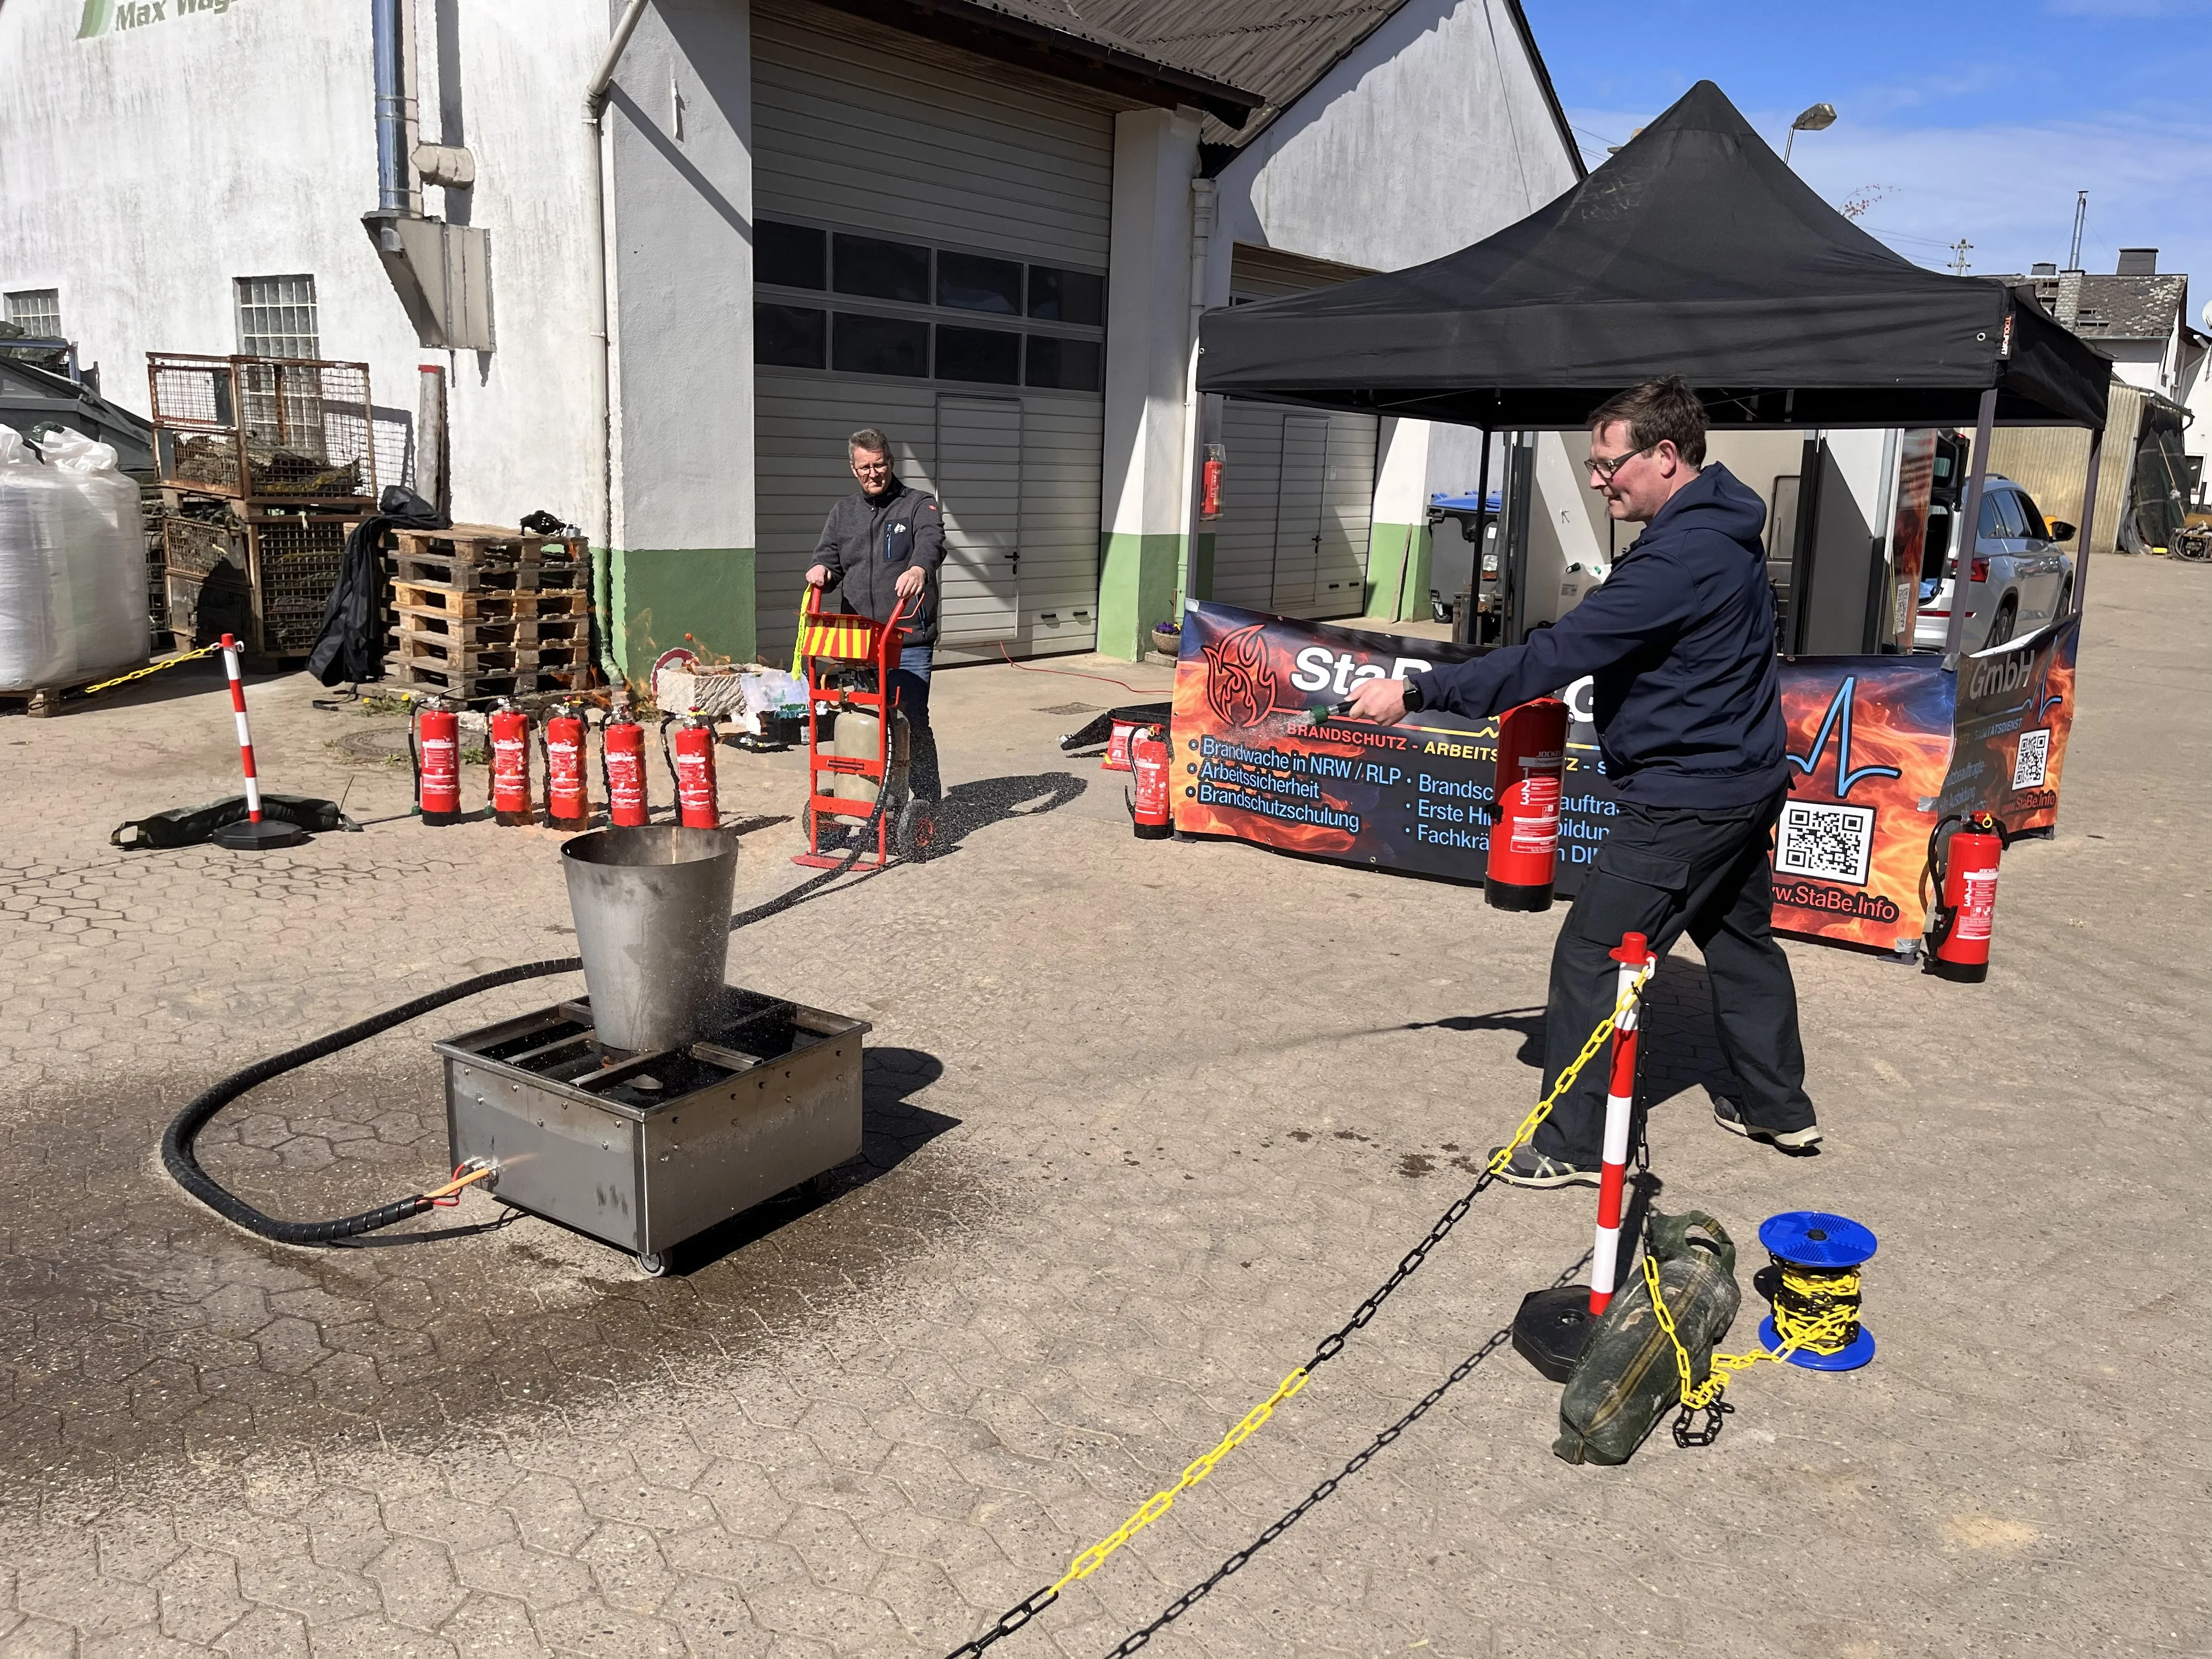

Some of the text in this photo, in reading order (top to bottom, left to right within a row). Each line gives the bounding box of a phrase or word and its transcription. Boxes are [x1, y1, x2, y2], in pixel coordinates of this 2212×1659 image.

[116, 0, 166, 30] Max
[2001, 315, 2012, 356] TOOLPORT
[1969, 649, 2035, 699] GmbH
[1287, 723, 1407, 751] BRANDSCHUTZ
[1203, 737, 1289, 770] Brandwache
[1292, 754, 1306, 771] in
[1310, 756, 1351, 778] NRW
[1365, 765, 1402, 785] RLP
[1522, 767, 1529, 780] 1
[1200, 761, 1319, 799] Arbeitssicherheit
[1521, 779, 1531, 792] 2
[1200, 784, 1359, 833] Brandschutzschulung
[1418, 799, 1464, 821] Erste
[1520, 792, 1530, 805] 3
[1417, 823, 1489, 851] Fachkrä
[1571, 845, 1598, 864] DI
[1964, 888, 1973, 898] 2
[1966, 880, 1972, 889] 1
[1773, 885, 1895, 919] w.StaBe.Info
[1963, 897, 1972, 907] 3
